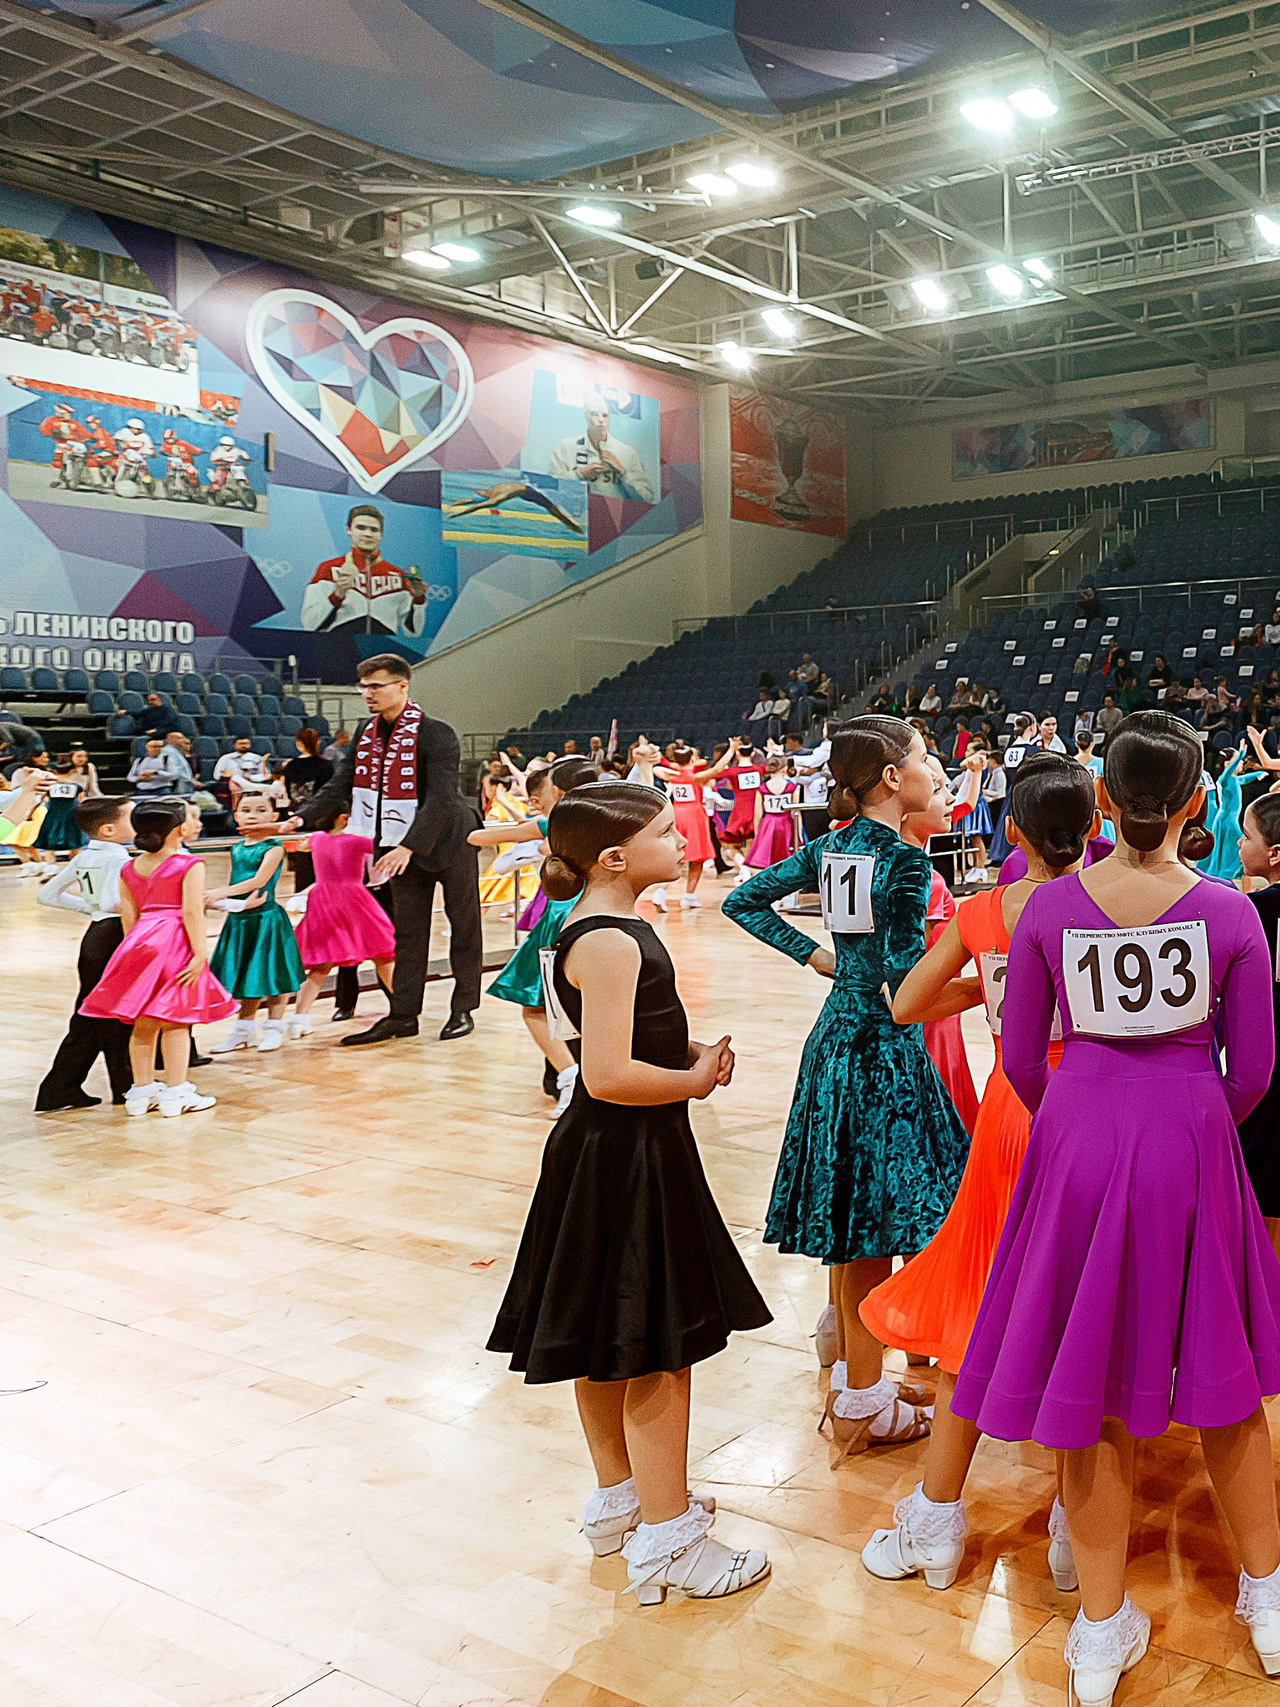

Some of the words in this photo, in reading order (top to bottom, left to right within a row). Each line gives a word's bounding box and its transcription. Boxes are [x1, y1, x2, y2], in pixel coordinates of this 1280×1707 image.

[13, 612, 195, 644] ЛЕНИНСКОГО
[84, 648, 196, 674] ОКРУГА
[1008, 751, 1019, 763] 83
[744, 775, 755, 785] 52
[675, 786, 688, 798] 62
[767, 797, 790, 809] 173
[823, 863, 857, 915] 11
[1077, 937, 1197, 1013] 193
